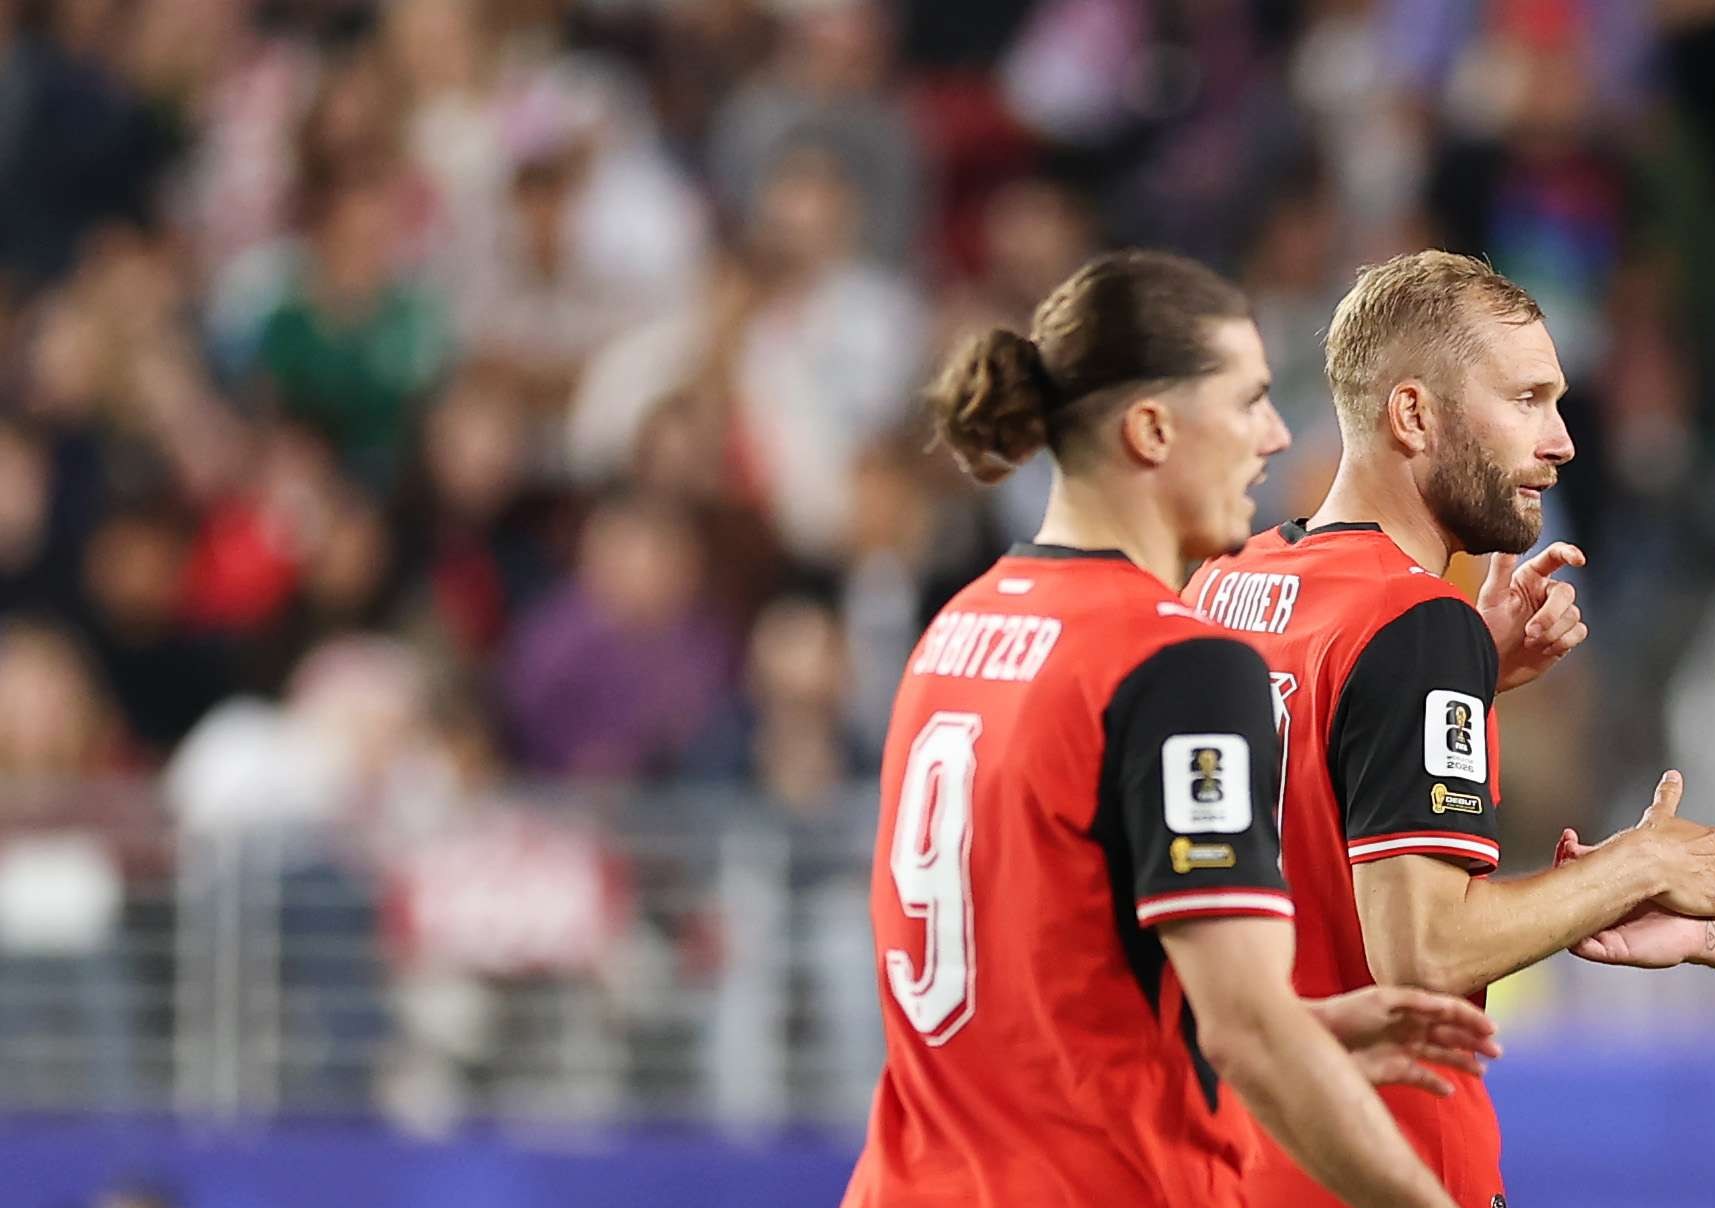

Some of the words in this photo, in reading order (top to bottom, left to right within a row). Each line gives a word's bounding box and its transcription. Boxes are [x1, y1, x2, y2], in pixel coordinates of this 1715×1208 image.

[1194, 568, 1300, 634] LAIMER
[1445, 796, 1477, 807] DEBUT
[886, 711, 983, 1046] 9
